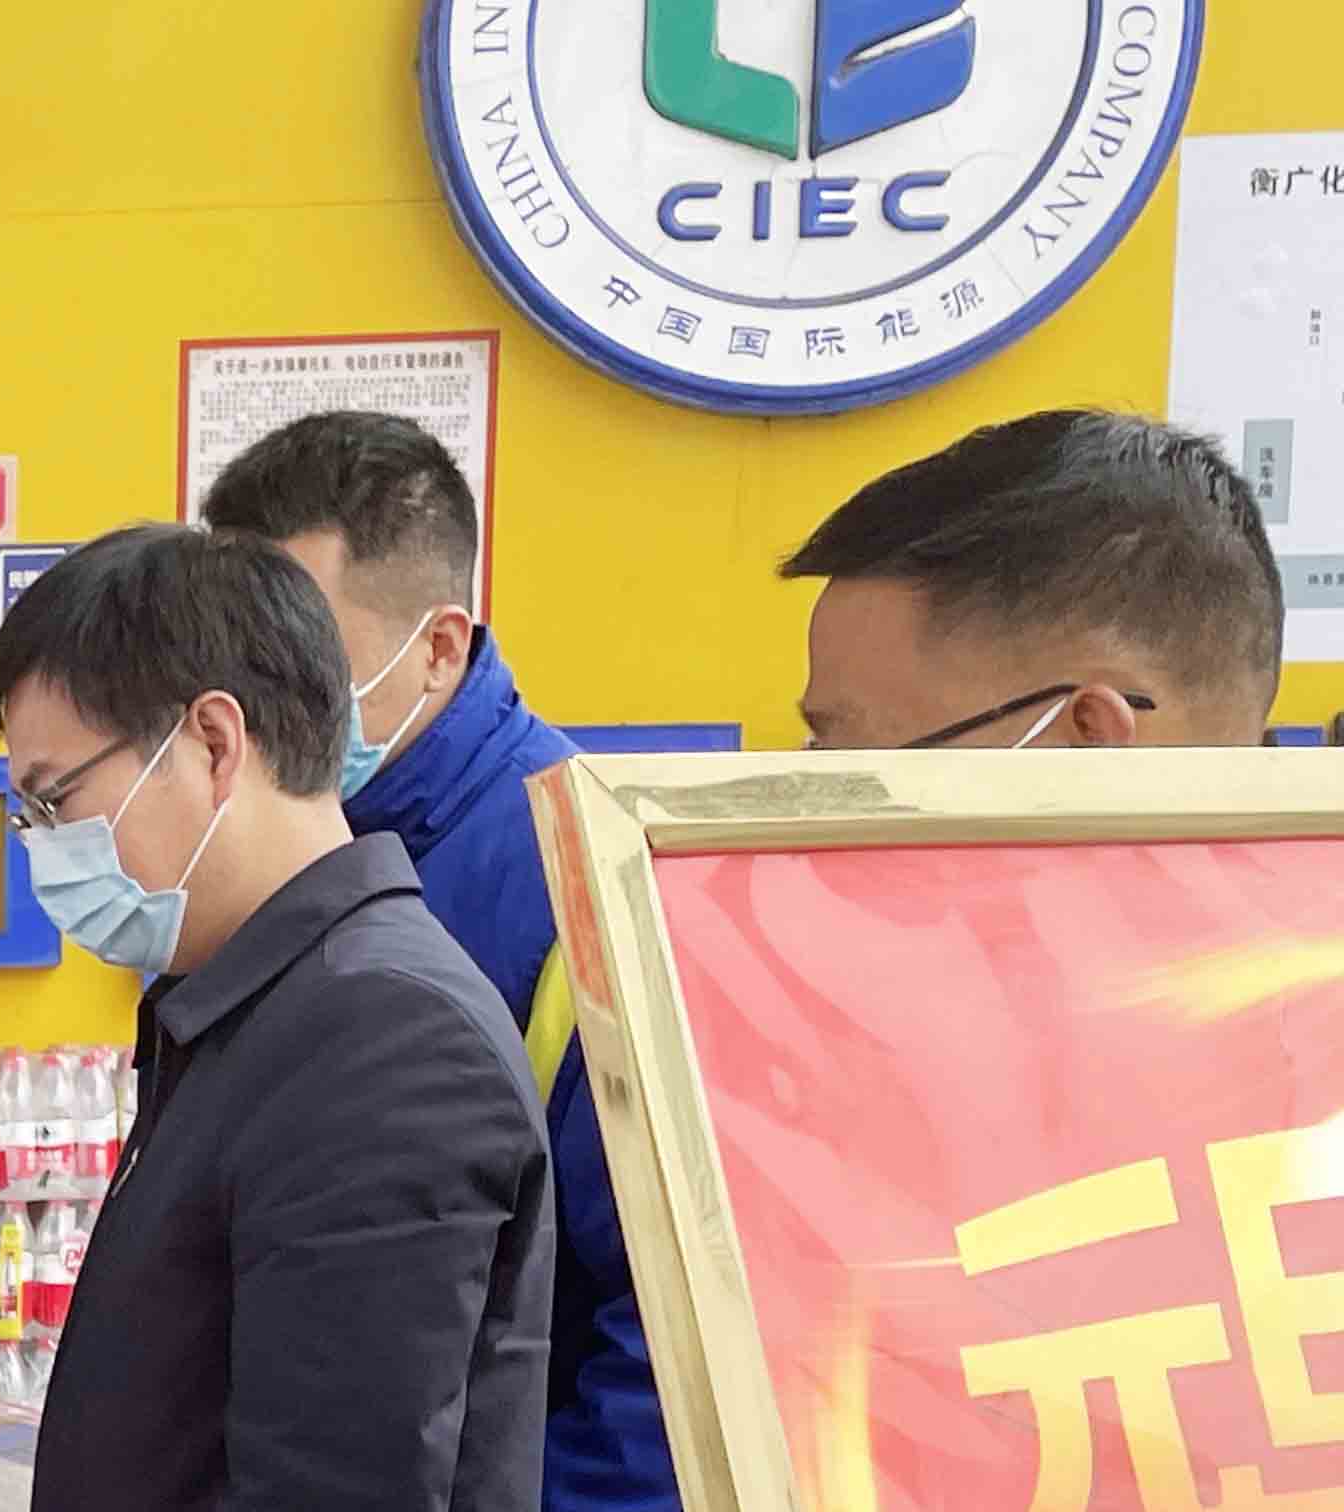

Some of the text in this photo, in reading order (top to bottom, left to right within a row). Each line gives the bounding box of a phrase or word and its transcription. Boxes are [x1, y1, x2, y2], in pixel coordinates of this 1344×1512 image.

[482, 88, 571, 249] CHINA
[1022, 3, 1158, 260] COMPANY
[657, 170, 952, 242] CIEC
[602, 275, 985, 360] 中国国际能源
